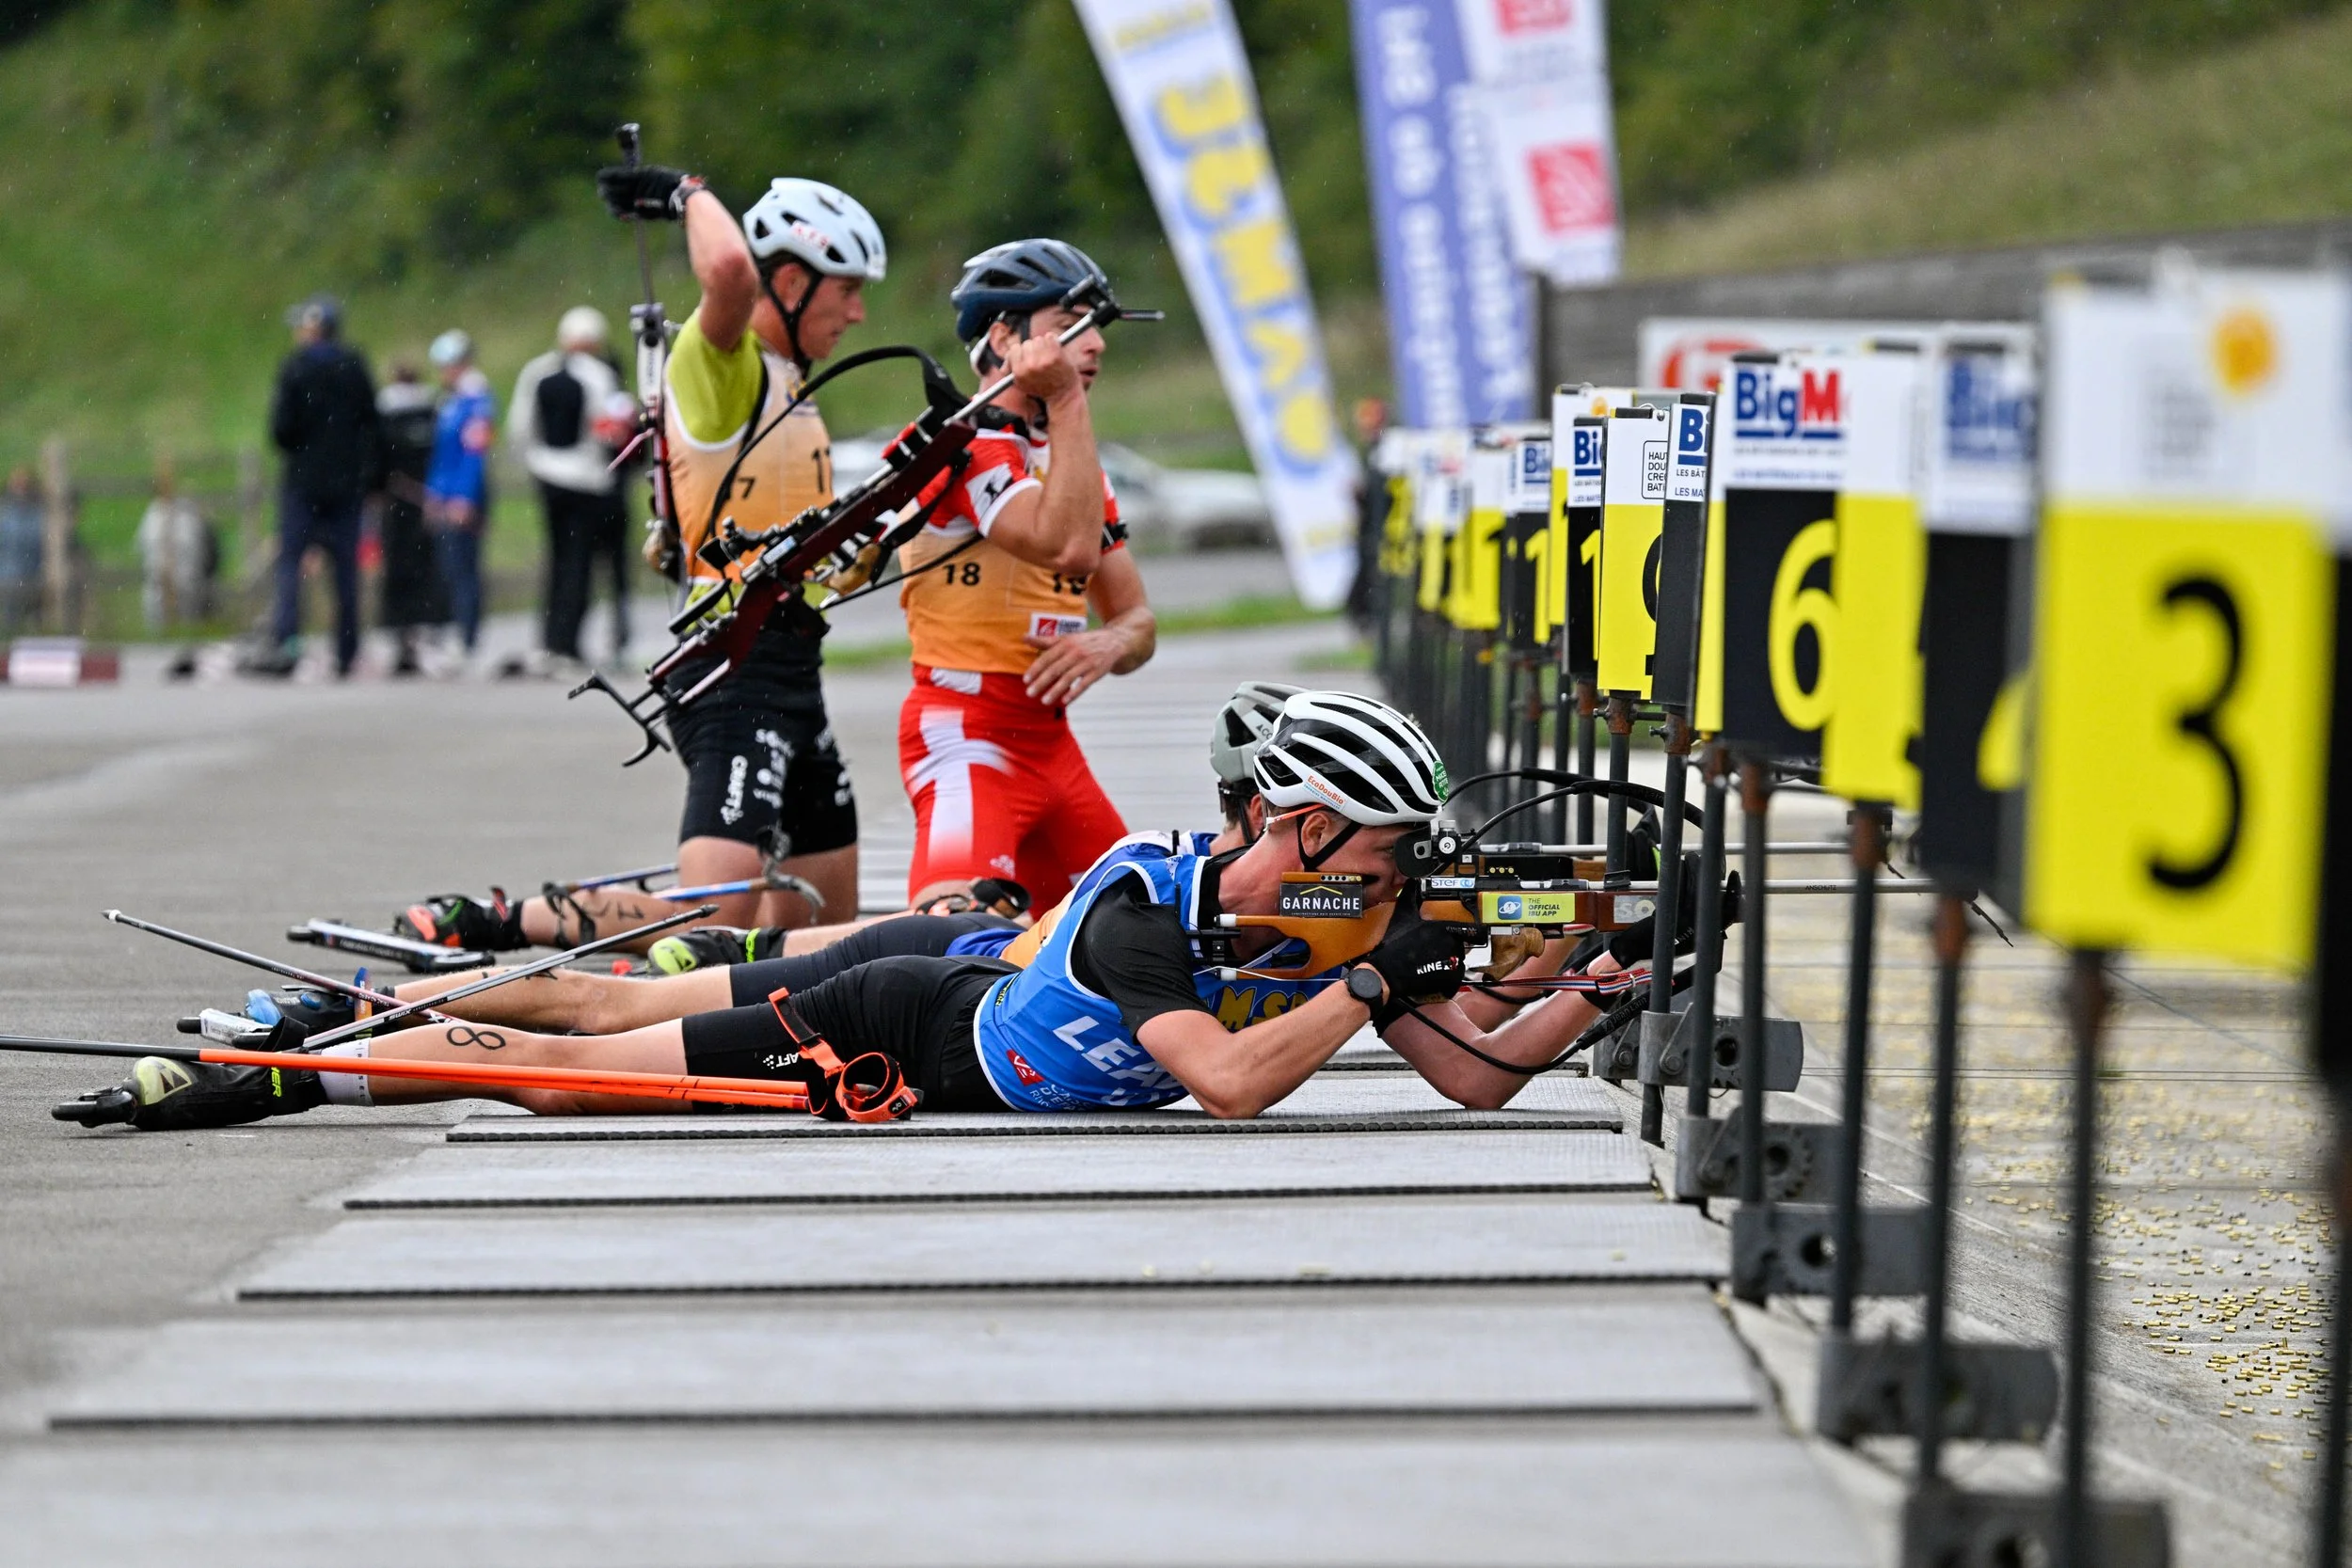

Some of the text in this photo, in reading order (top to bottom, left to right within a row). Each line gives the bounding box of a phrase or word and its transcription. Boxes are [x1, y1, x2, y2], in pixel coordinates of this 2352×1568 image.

[1735, 370, 1840, 439] BigM
[1574, 430, 1602, 466] Bi
[1648, 463, 1666, 471] DOU
[1691, 469, 1707, 479] BÂT
[738, 476, 755, 499] 7
[1675, 487, 1690, 496] LES
[943, 562, 980, 586] 18
[1524, 528, 1549, 644] 1
[1581, 529, 1601, 661] 1
[1769, 518, 1838, 732] 6
[2147, 574, 2243, 894] 3
[1308, 775, 1344, 805] EcoDouBio
[1282, 896, 1360, 911] GARNACHE
[389, 1008, 412, 1022] SWIX
[775, 1052, 799, 1069] AFT
